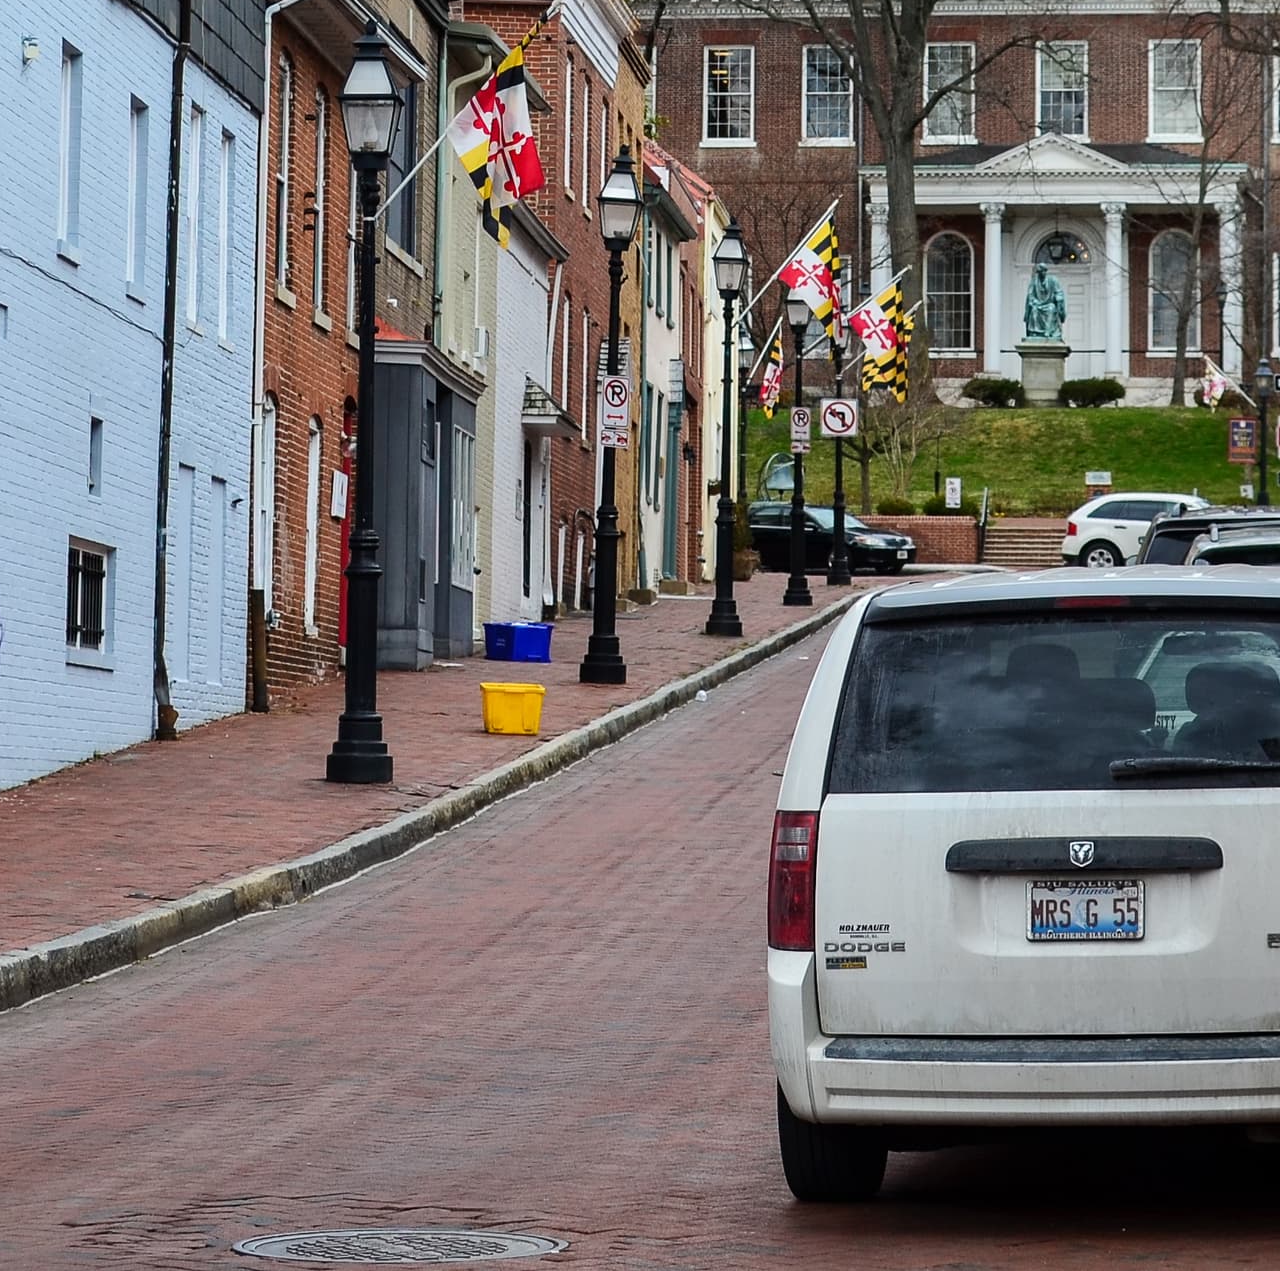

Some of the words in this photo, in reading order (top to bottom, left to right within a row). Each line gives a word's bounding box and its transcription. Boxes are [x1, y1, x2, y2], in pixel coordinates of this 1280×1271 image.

[1032, 898, 1071, 928] MRS
[1086, 899, 1099, 927] G
[1113, 898, 1139, 927] 55
[824, 942, 906, 953] DODGE
